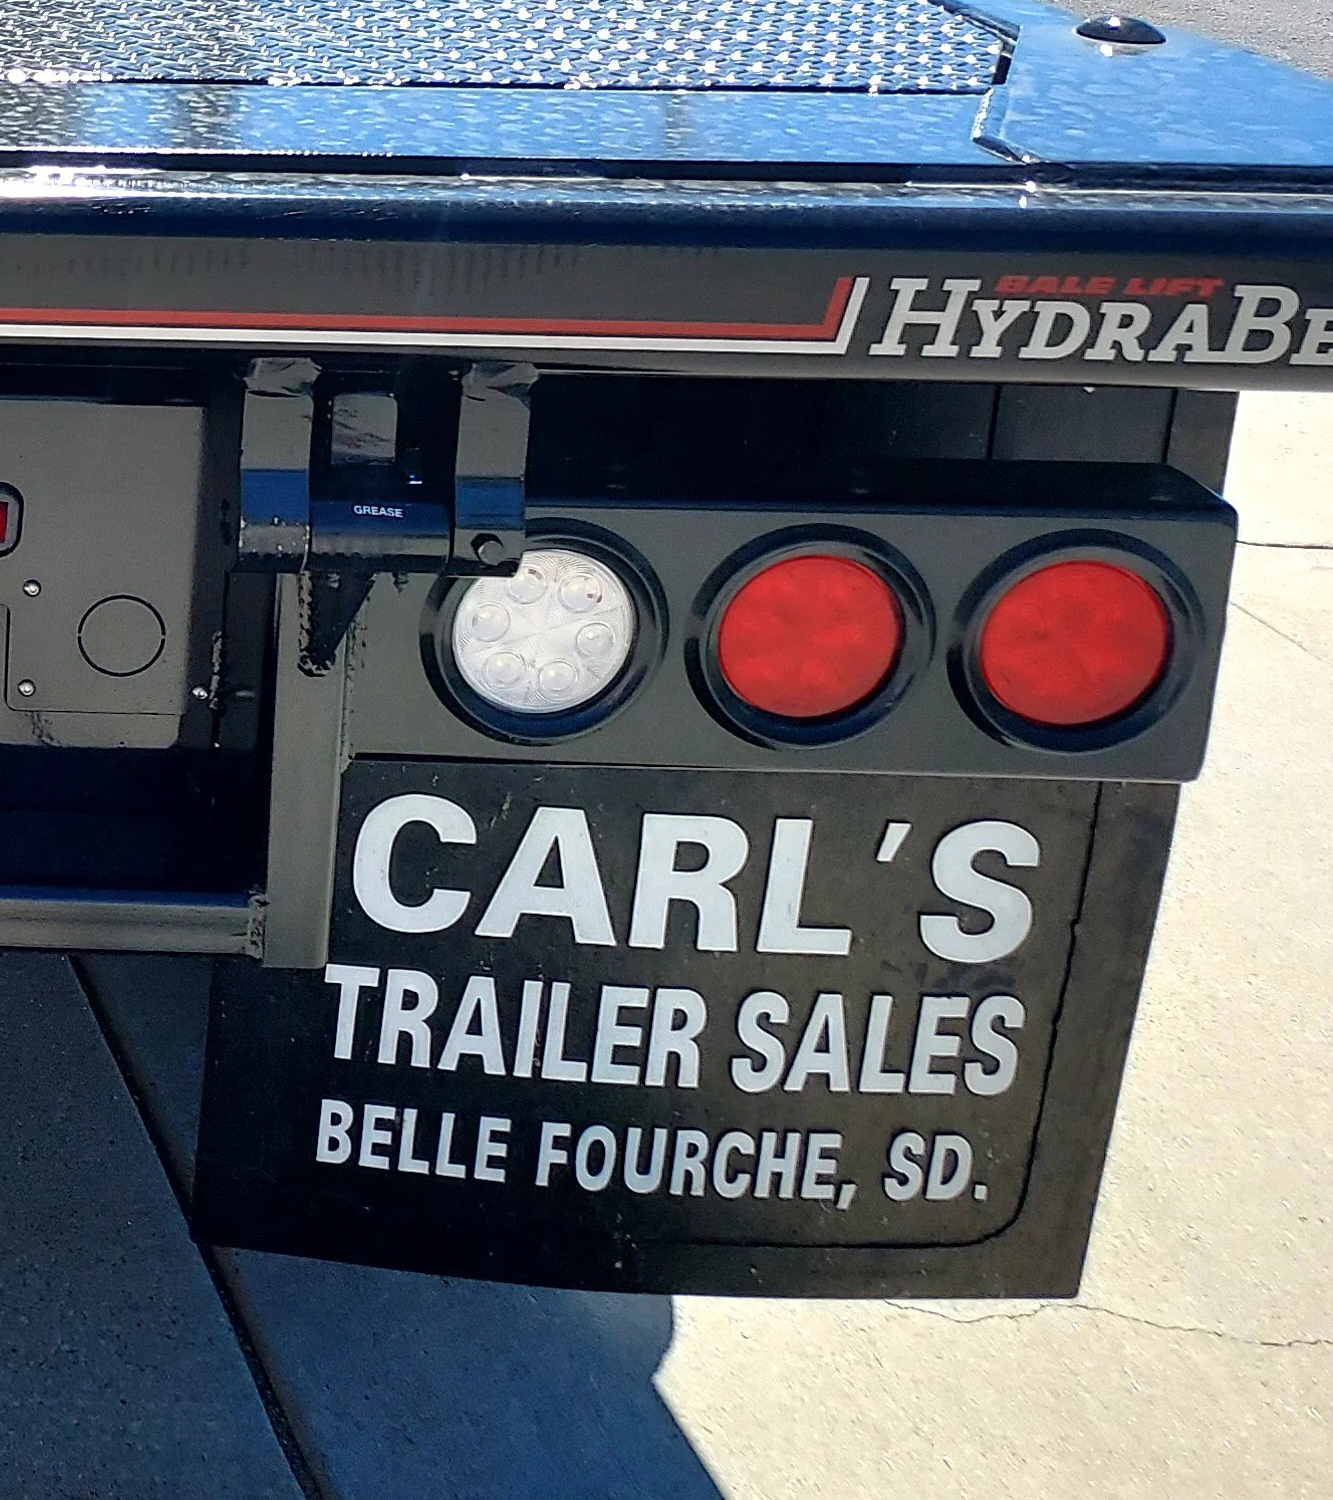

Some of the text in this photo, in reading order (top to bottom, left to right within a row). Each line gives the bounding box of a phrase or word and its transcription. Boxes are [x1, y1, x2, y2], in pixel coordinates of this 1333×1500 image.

[994, 275, 1224, 297] BALE LIFT
[353, 505, 404, 518] GREASE
[352, 793, 1041, 965] CARL'S
[324, 963, 1025, 1097] TRAILER SALES
[315, 1099, 988, 1210] BELLE FOURCHE, SD.
